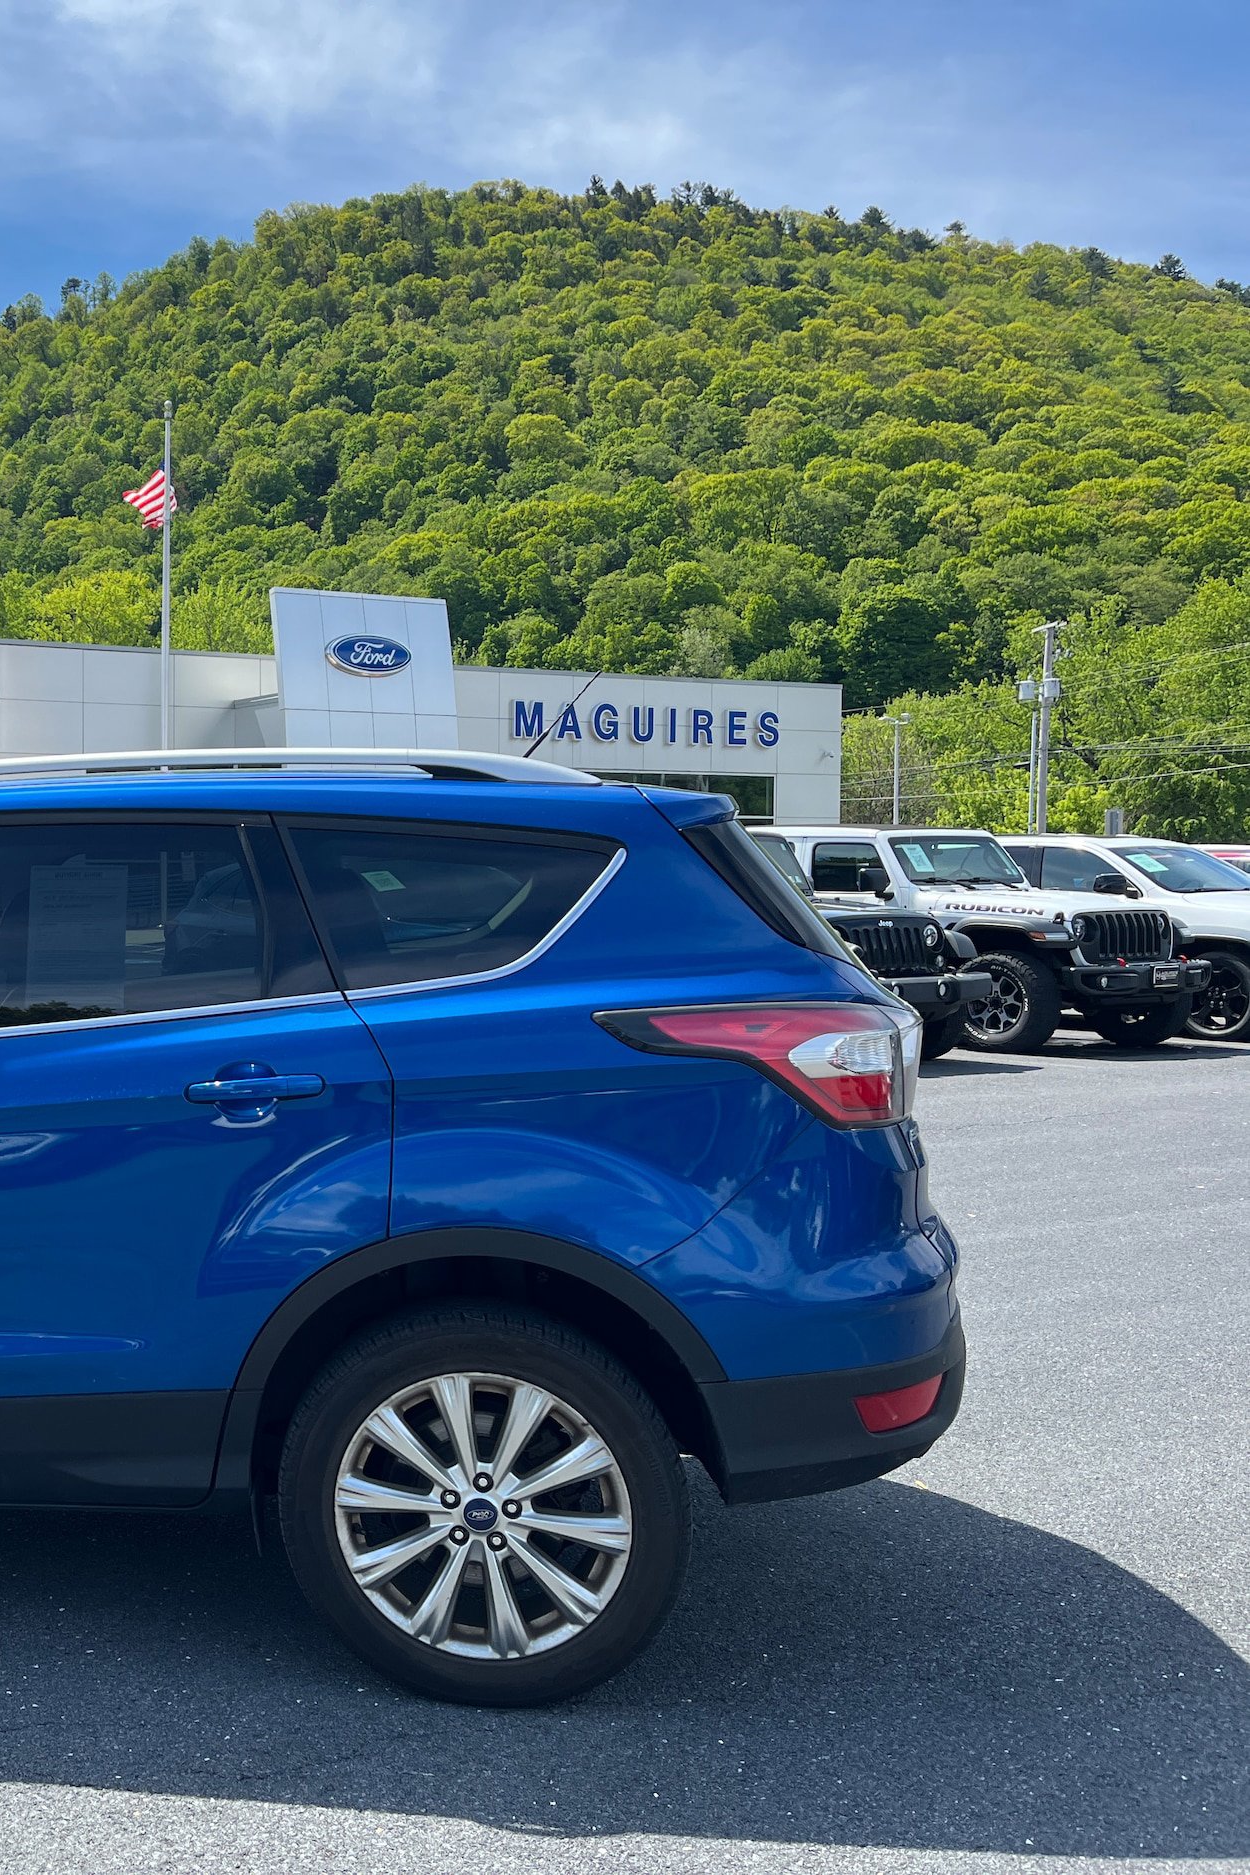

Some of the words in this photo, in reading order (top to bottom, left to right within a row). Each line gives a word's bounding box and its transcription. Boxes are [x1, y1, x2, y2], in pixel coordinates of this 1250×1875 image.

[350, 641, 396, 666] Ford
[513, 700, 780, 748] MAGUIRES
[945, 903, 1045, 916] RUBICON
[878, 920, 894, 928] Jeep
